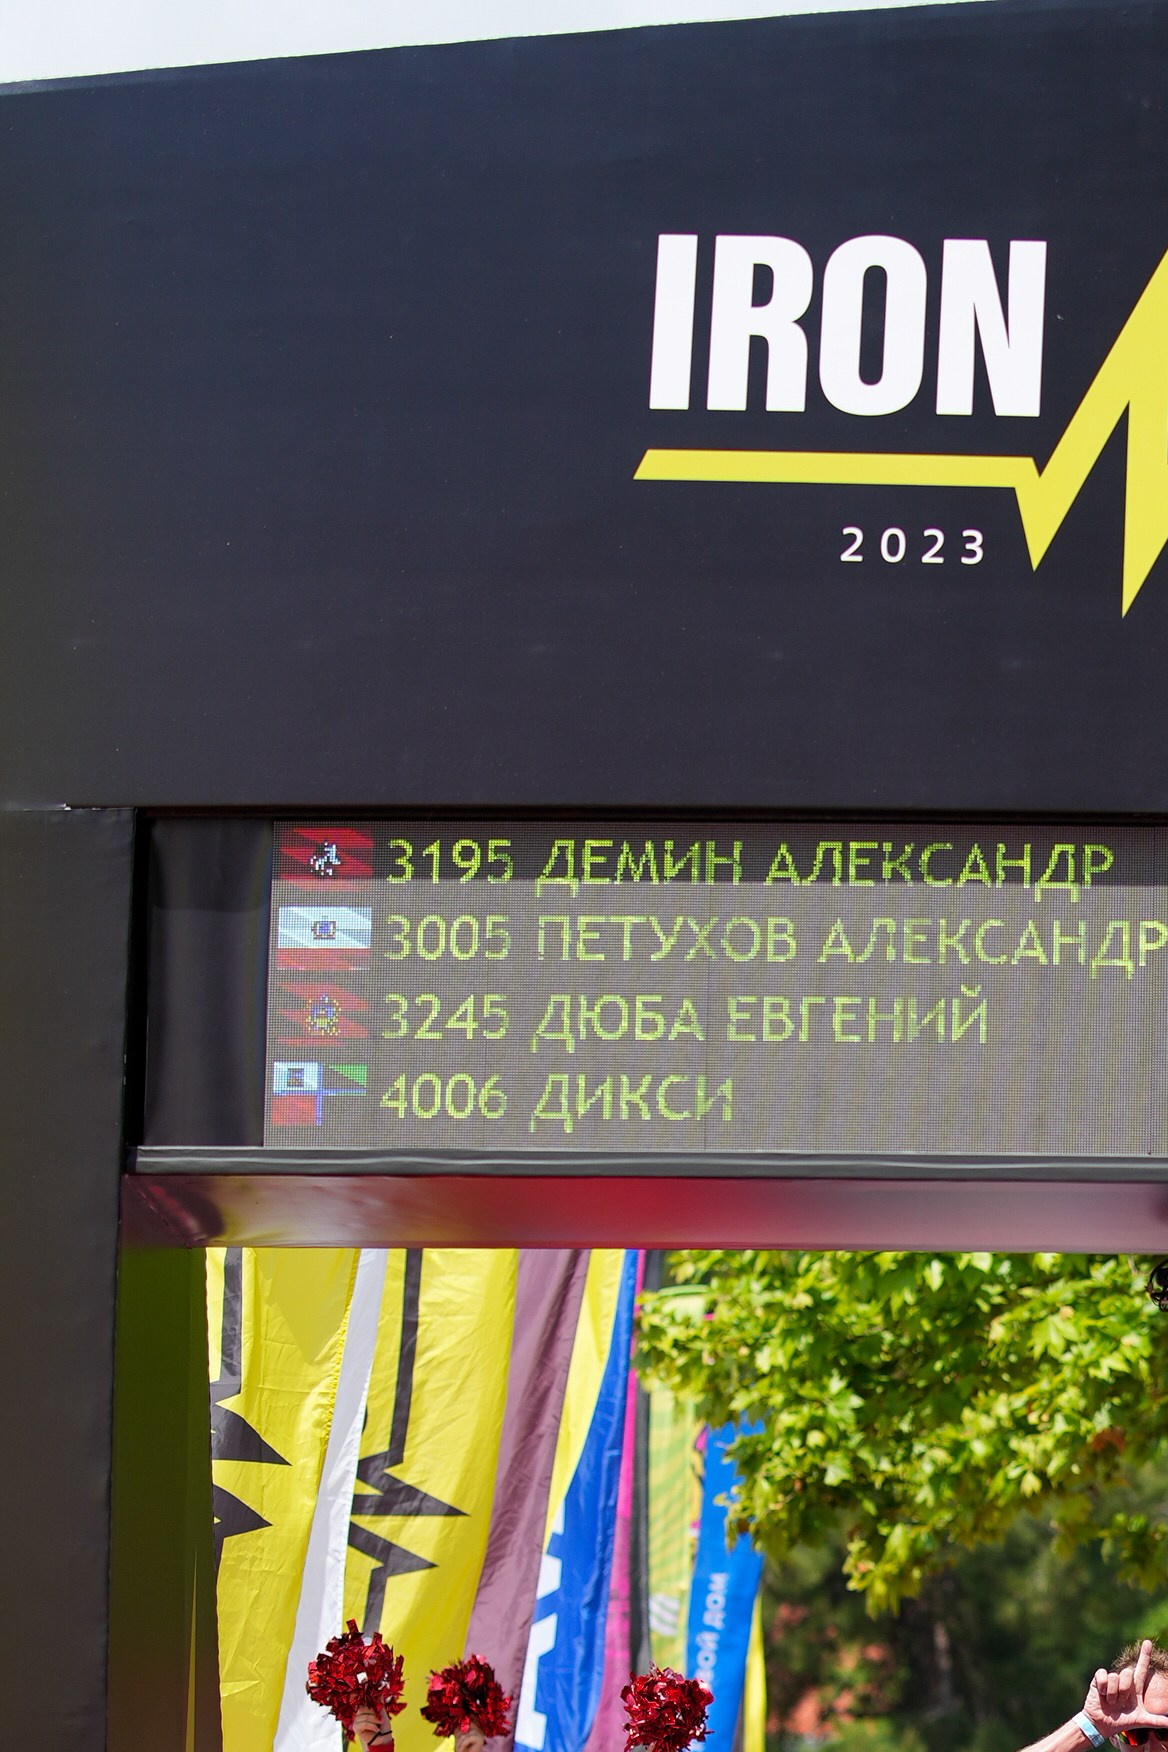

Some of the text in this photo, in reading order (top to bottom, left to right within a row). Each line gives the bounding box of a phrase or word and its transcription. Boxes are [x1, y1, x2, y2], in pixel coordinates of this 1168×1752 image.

[649, 233, 1047, 417] IRON
[839, 526, 985, 565] 2023
[386, 839, 513, 884] 3195
[535, 839, 743, 898] ДЕМИН
[764, 841, 1115, 902] АЛЕКСАНДР
[384, 915, 511, 961] 3005
[536, 915, 797, 964] ПЕТУХОВ
[381, 994, 510, 1042] 3245
[532, 994, 706, 1053] ДЮБА
[728, 984, 988, 1044] ЕВГЕНИЙ
[380, 1071, 508, 1120] 4006
[531, 1073, 734, 1132] ДИКСИ
